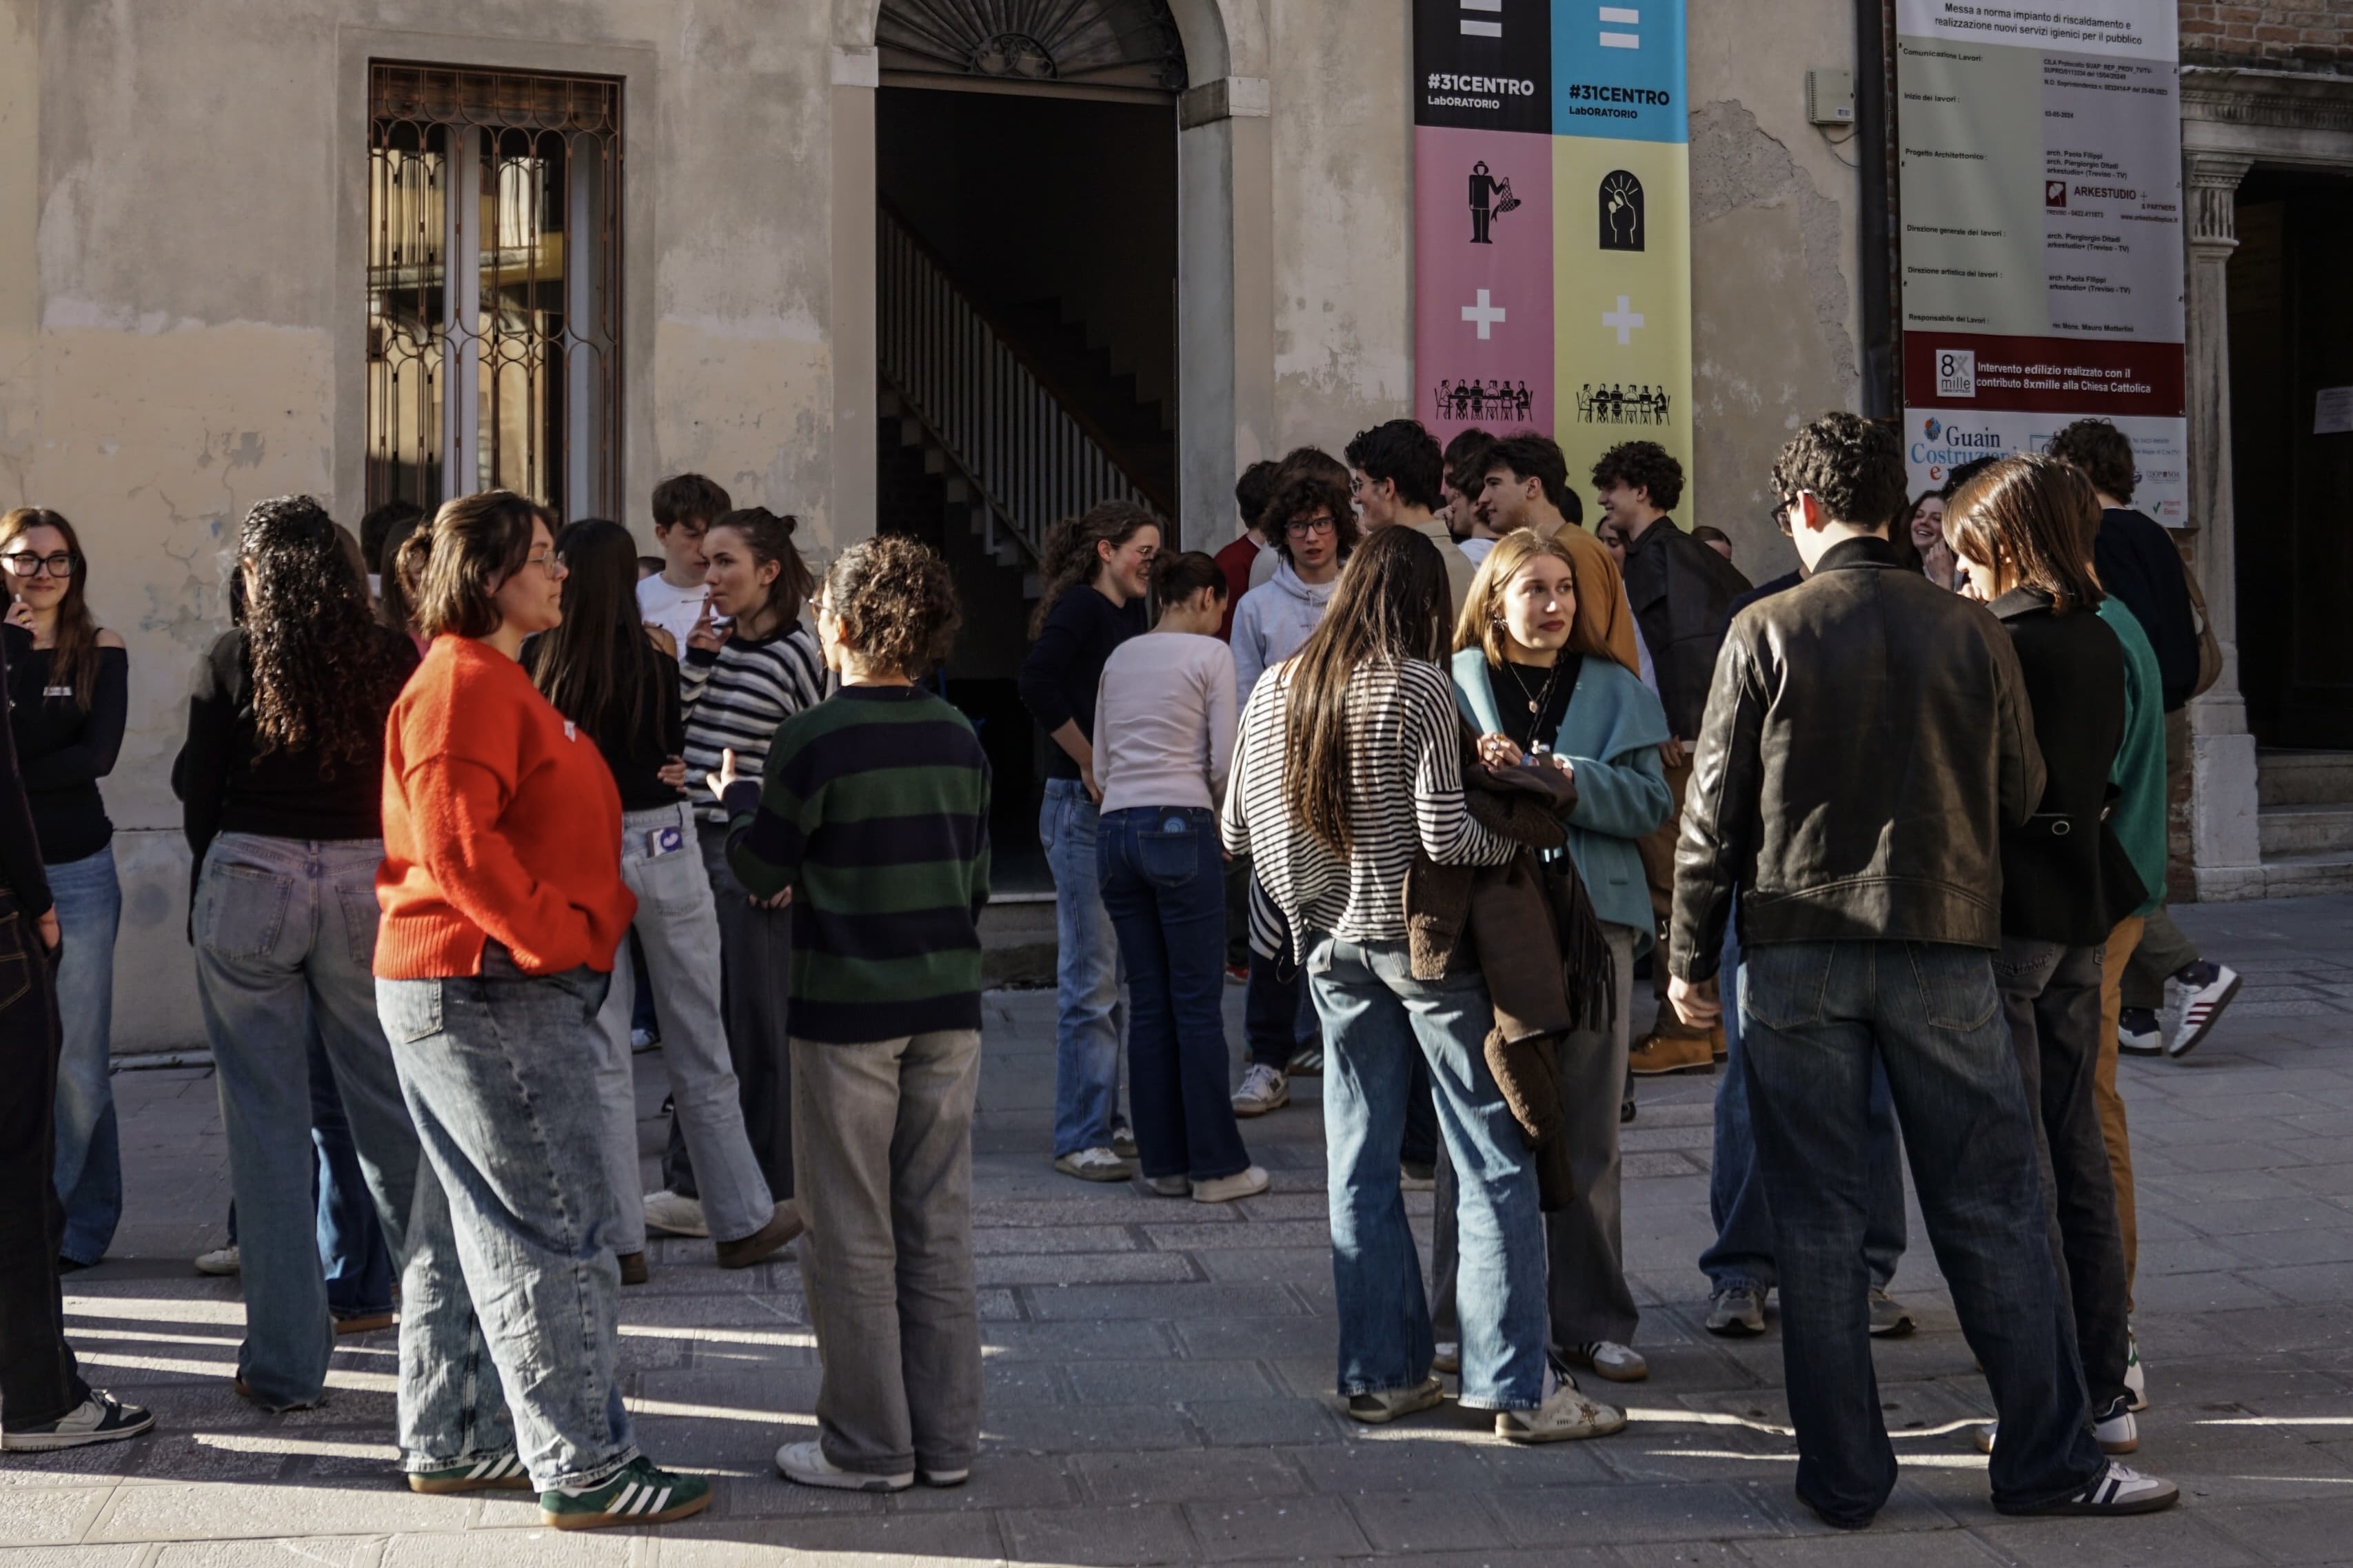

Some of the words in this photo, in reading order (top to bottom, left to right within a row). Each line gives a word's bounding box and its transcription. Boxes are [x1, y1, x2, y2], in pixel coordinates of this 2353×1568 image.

[1946, 3, 1974, 14] Messa
[1984, 8, 2011, 18] norma
[2013, 10, 2052, 21] impianto
[2053, 14, 2061, 23] di
[2063, 15, 2123, 29] riscaldamento
[1935, 18, 1992, 30] realizzazione
[1995, 23, 2017, 33] nuovi
[2019, 26, 2048, 36] servizi
[2050, 28, 2079, 39] igienici
[2082, 33, 2096, 41] per
[2099, 32, 2103, 41] il
[2105, 34, 2142, 45] pubblico
[1903, 48, 1957, 59] Comunicazione
[1959, 54, 1983, 62] Lavori:
[1428, 73, 1534, 96] #31CENTRO
[1569, 84, 1670, 106] #31CENTRO
[1904, 92, 1921, 101] Inizio
[1428, 95, 1499, 109] LabORATORIO
[1569, 106, 1638, 119] LabORATORIO
[1906, 148, 1933, 157] Progetto
[1935, 151, 1984, 160] Architettonico
[2083, 152, 2103, 160] Filippi
[2064, 160, 2099, 169] Piergiorgio
[2086, 170, 2111, 178] (Treviso
[2117, 172, 2128, 181] TV)
[2074, 186, 2137, 200] ARKESTUDIO
[1907, 225, 1938, 233] Direzione
[2066, 234, 2100, 243] Piergiorgio
[2088, 244, 2112, 252] (Treviso
[2119, 245, 2129, 254] TV)
[1908, 266, 1939, 274] Direzione
[2086, 276, 2105, 284] Filippi
[2119, 287, 2130, 295] TV)
[1908, 314, 1954, 322] Responsabile
[1977, 362, 2021, 374] Intervento
[2024, 364, 2061, 375] edilizio
[2064, 367, 2103, 377] realizzato
[2105, 369, 2122, 378] con
[2125, 368, 2130, 378] il
[1941, 377, 1970, 389] mille
[1976, 378, 2021, 388] contributo
[2024, 379, 2060, 389] 8xmille
[2063, 380, 2079, 390] alla
[2081, 380, 2108, 391] Chiesa
[2111, 382, 2151, 393] Cattolica
[1946, 426, 2001, 448] Guain
[1930, 465, 1941, 481] e
